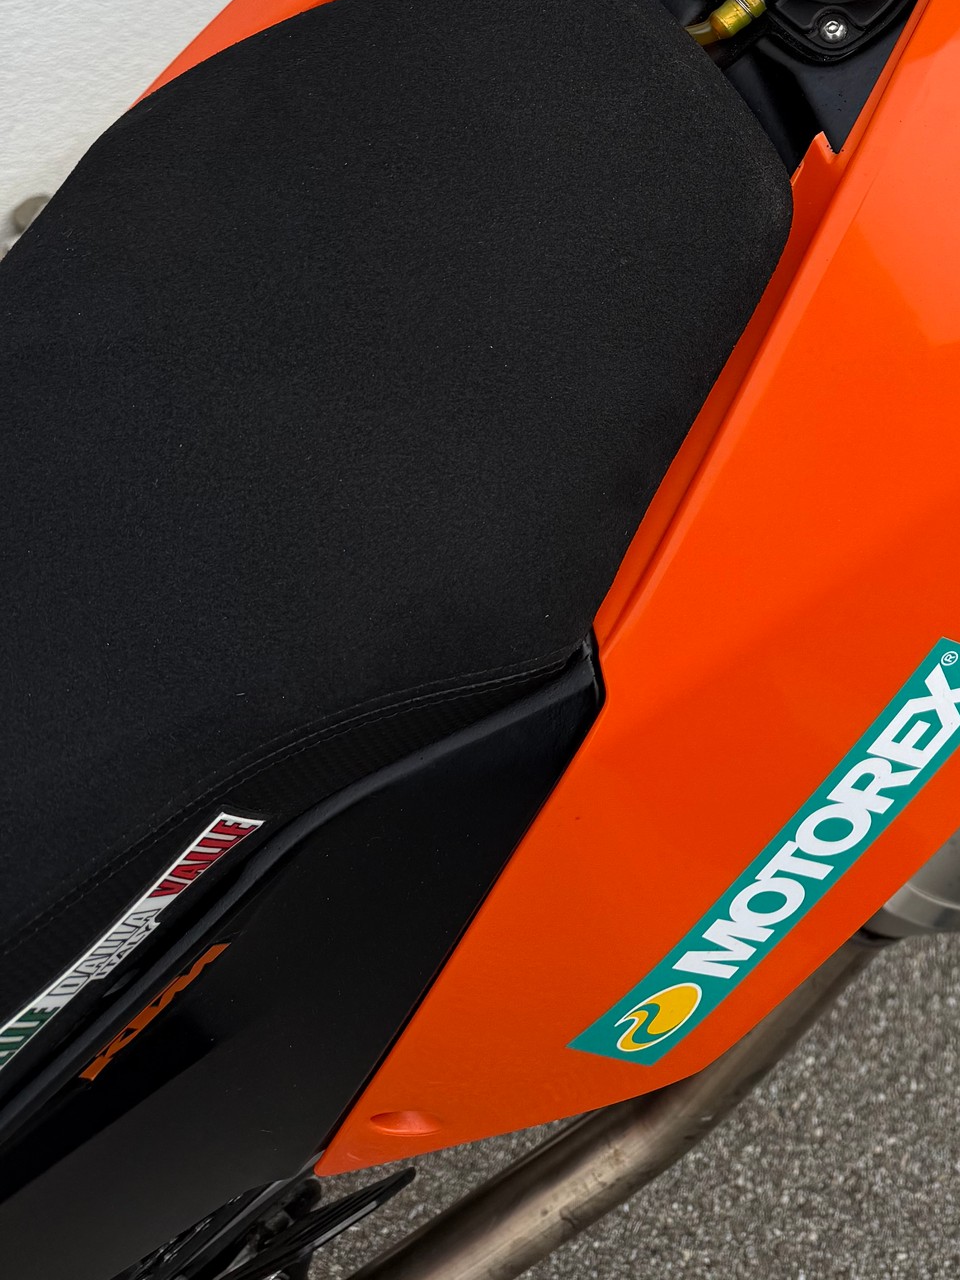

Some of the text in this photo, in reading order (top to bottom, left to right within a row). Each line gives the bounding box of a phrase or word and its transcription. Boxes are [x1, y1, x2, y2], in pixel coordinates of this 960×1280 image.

[47, 908, 162, 996] DALLA
[147, 819, 258, 897] VALLE
[95, 924, 155, 980] ITALY
[78, 942, 232, 1081] KTM
